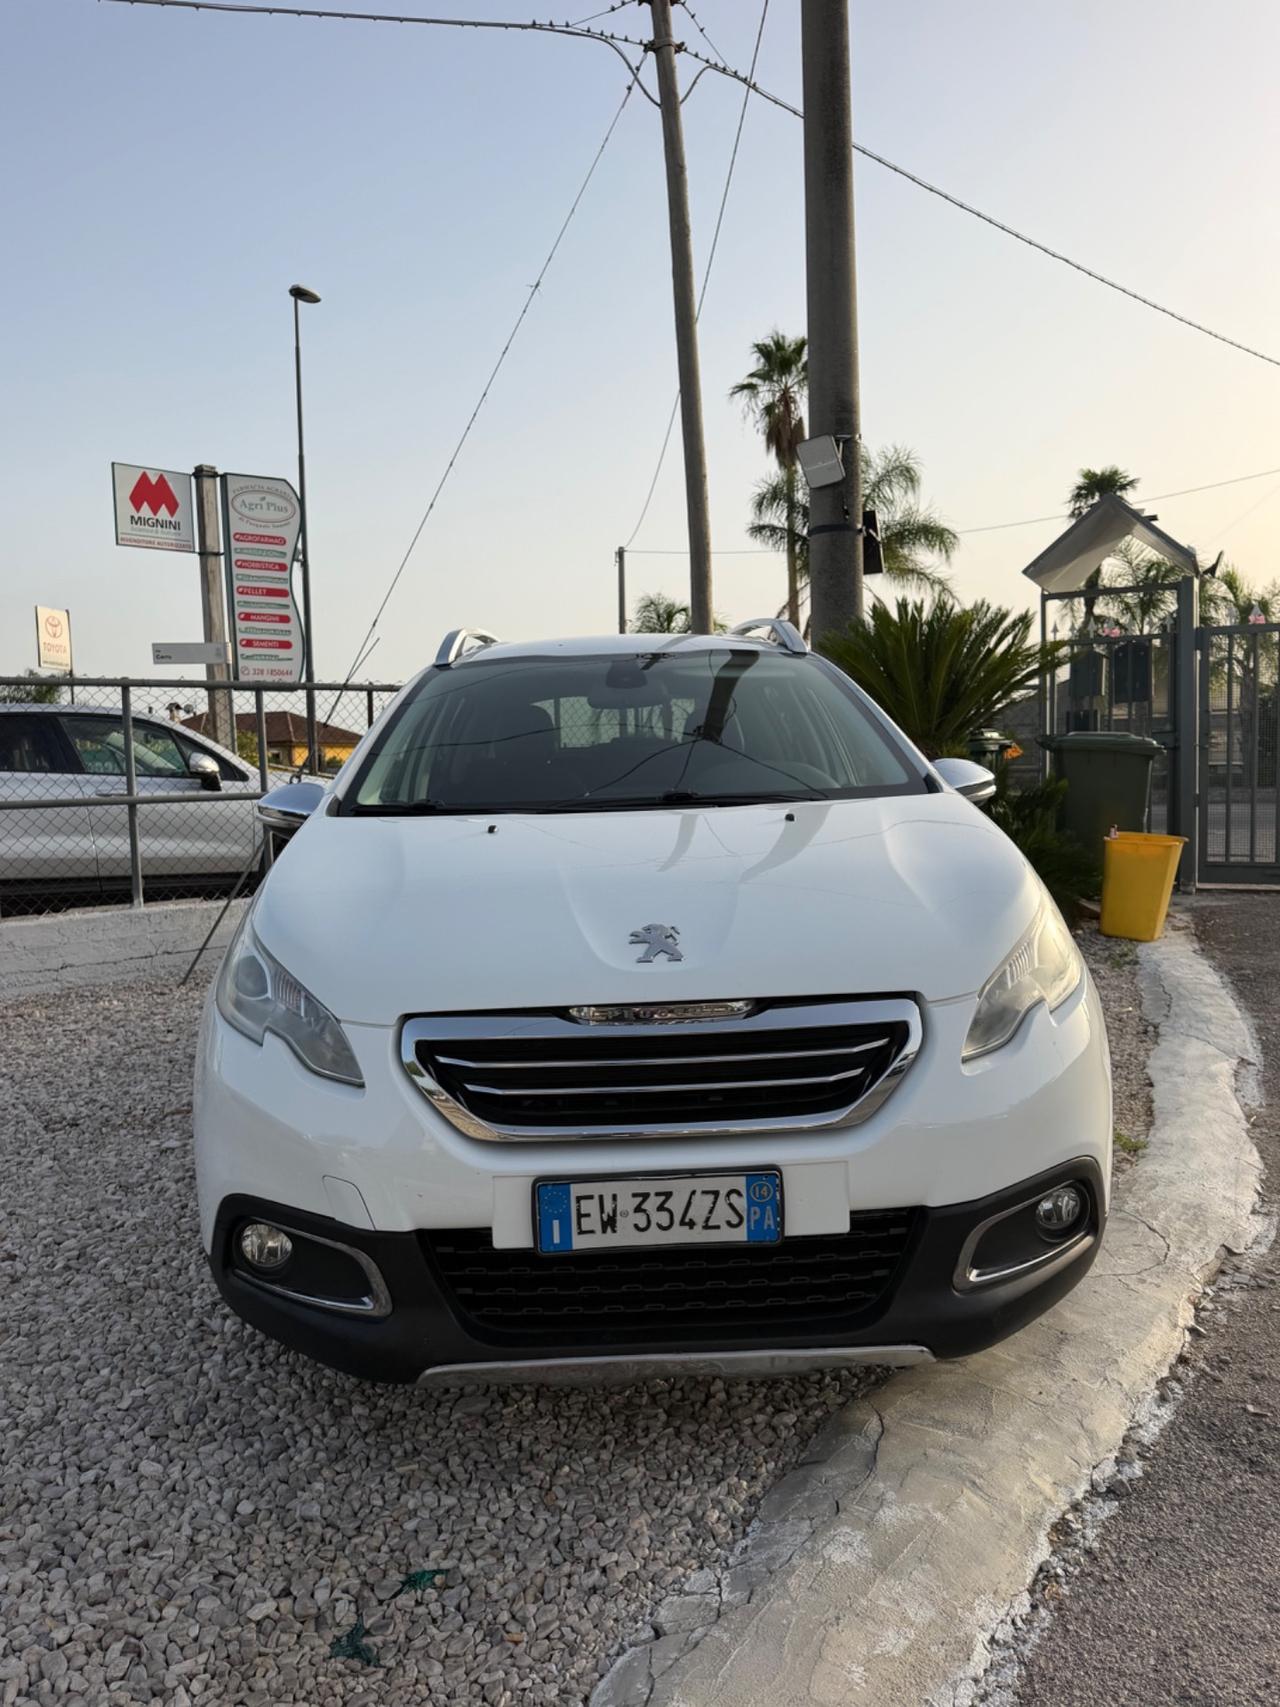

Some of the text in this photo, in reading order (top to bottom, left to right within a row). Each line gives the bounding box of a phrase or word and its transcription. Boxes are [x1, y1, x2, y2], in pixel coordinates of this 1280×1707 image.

[240, 496, 288, 513] Agri Plus
[130, 515, 181, 531] MIGNINI
[244, 588, 267, 596] PELLET
[43, 642, 68, 655] TOYOTA
[754, 1185, 769, 1199] 14
[751, 1206, 775, 1231] PA
